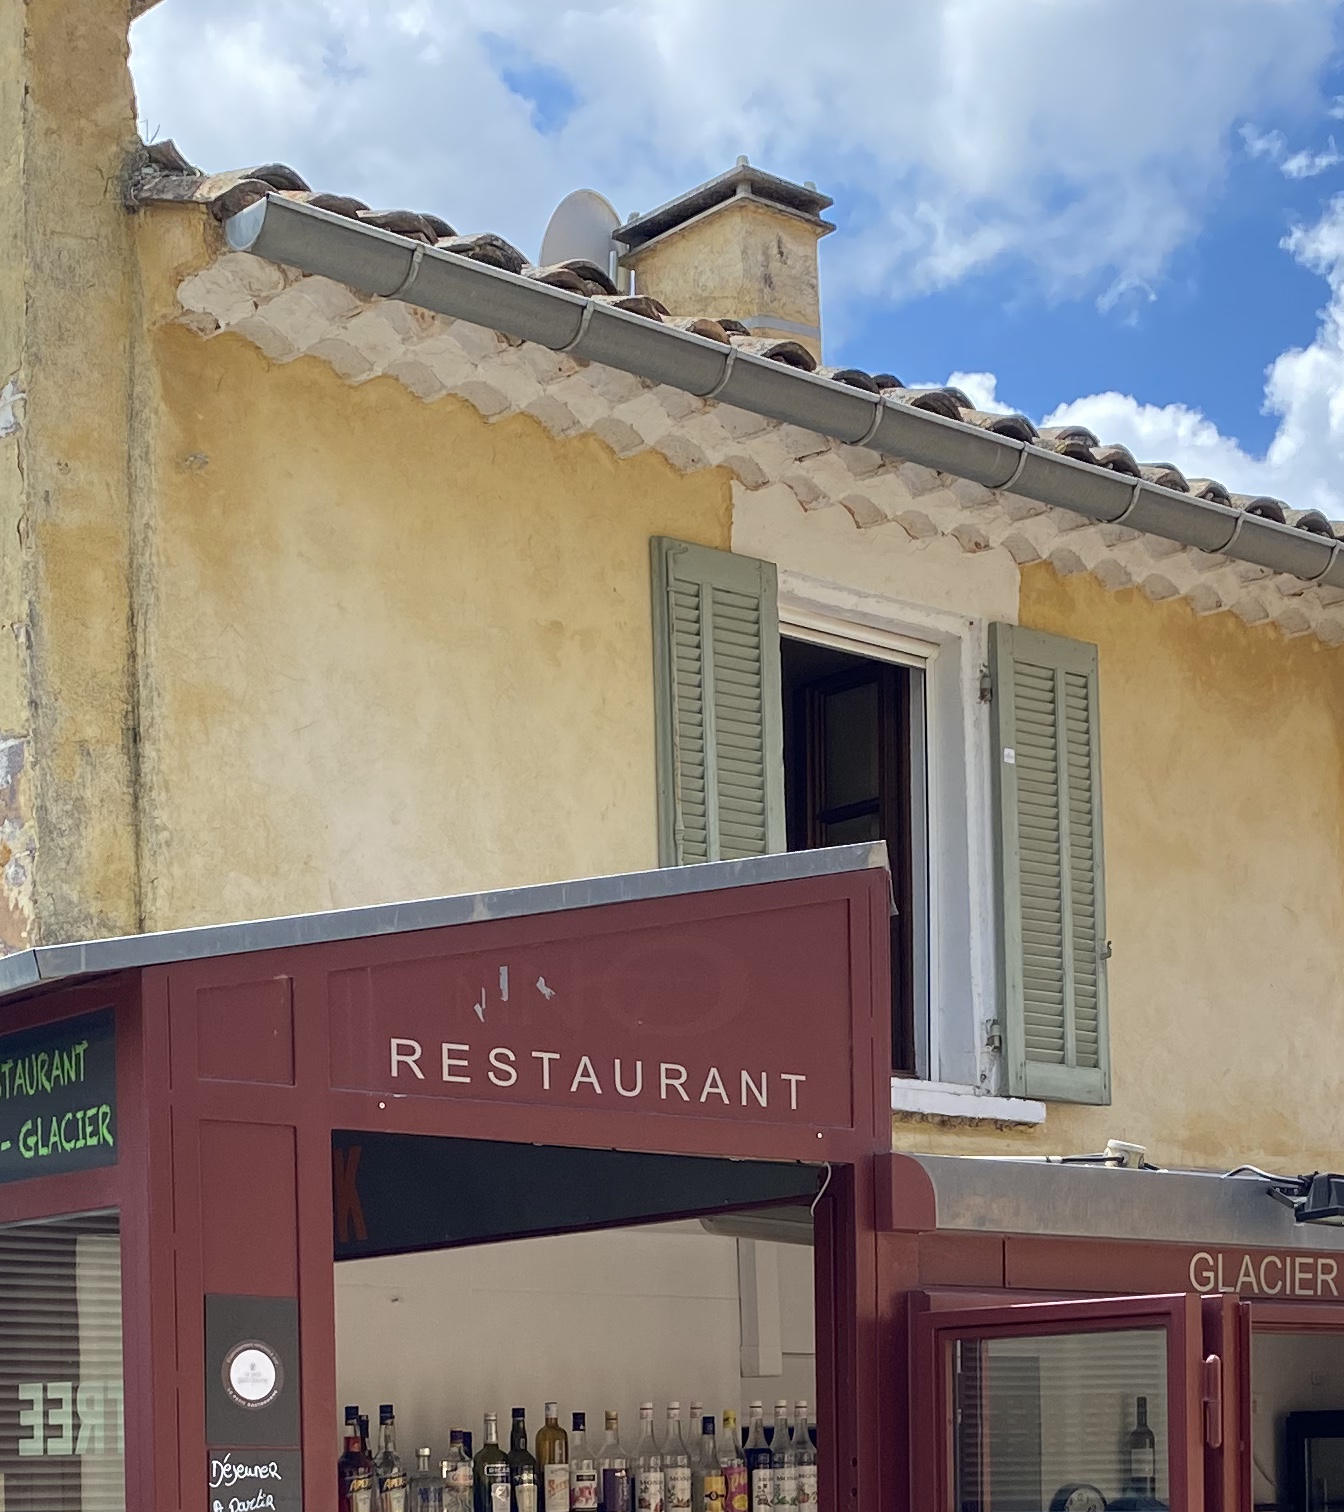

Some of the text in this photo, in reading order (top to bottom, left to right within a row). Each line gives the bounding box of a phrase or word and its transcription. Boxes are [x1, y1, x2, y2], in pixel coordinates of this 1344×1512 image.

[391, 1038, 807, 1110] RESTAURANT
[19, 1104, 113, 1159] GLACIER
[1189, 1252, 1338, 1296] GLACIER
